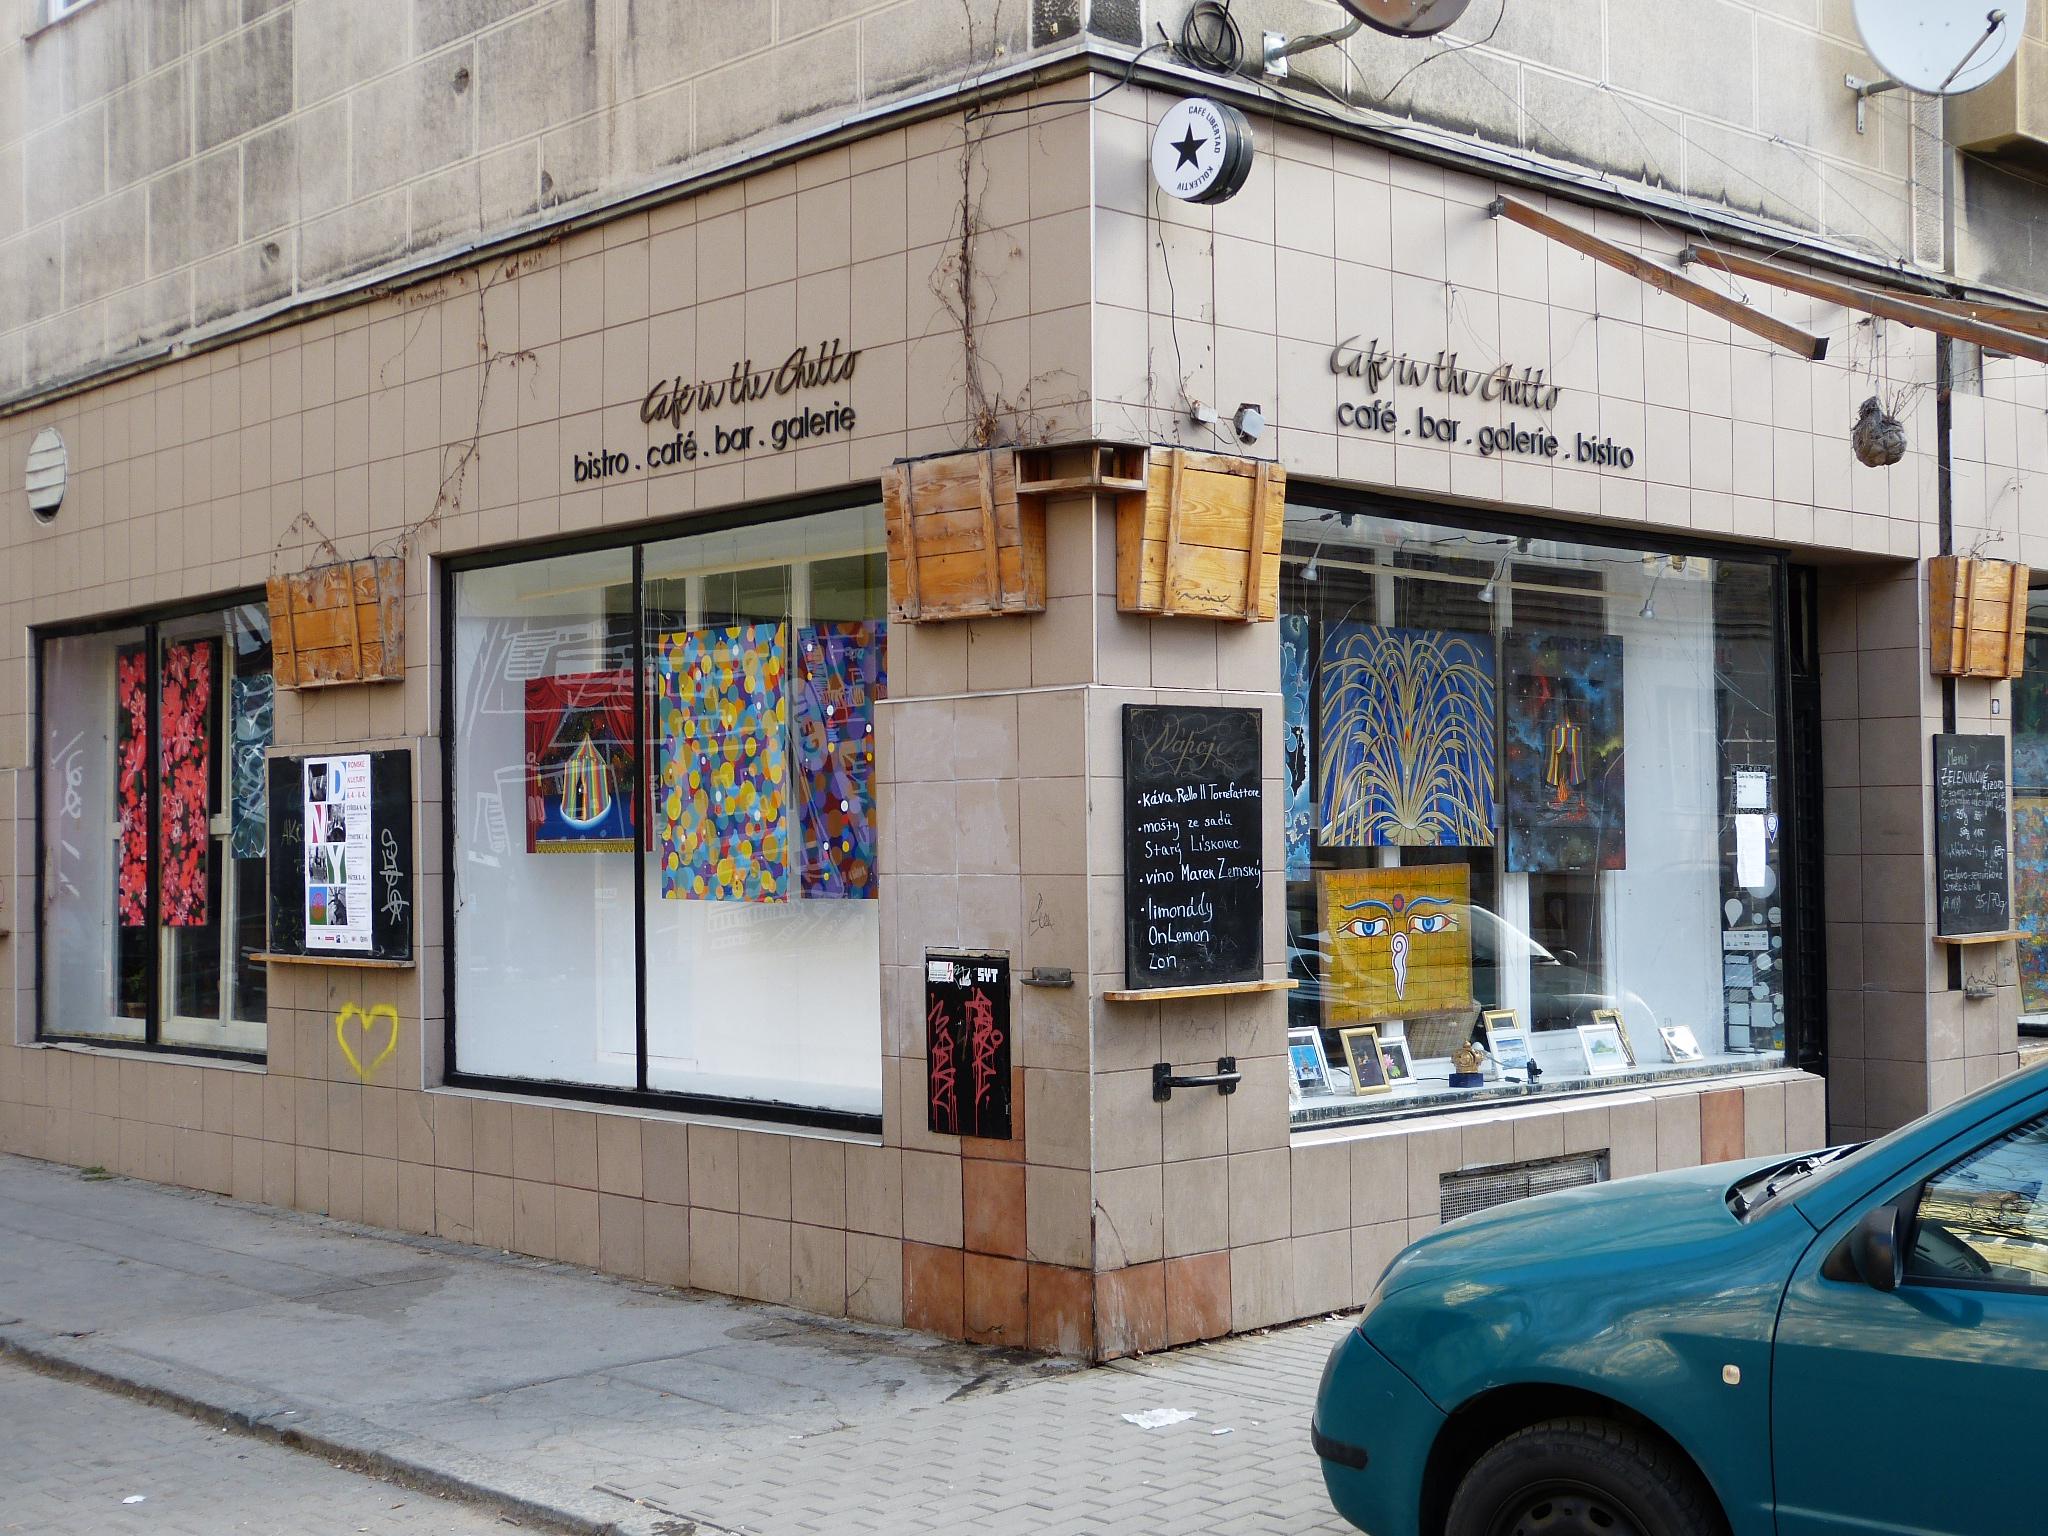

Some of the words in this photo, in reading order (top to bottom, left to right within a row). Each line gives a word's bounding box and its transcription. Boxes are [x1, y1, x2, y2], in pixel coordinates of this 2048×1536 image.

[1189, 106, 1207, 117] CAFÉ
[1206, 113, 1221, 154] LIBERTAD
[1176, 165, 1214, 191] KOLLEKTIV
[640, 375, 697, 429] Café
[698, 380, 726, 411] in
[729, 359, 775, 404] the
[774, 338, 863, 395] Ghetto
[1329, 334, 1395, 394] Café
[1397, 353, 1430, 387] in
[1432, 350, 1482, 396] the
[1480, 361, 1563, 411] Ghetto
[574, 449, 629, 482] bistro
[647, 431, 697, 467] café
[715, 424, 754, 454] bar
[771, 401, 856, 450] galerie
[1337, 399, 1397, 433] café
[1418, 406, 1461, 443] bar
[1479, 422, 1559, 456] galerie
[1577, 432, 1635, 469] bistro
[1143, 817, 1180, 841] mošty
[1188, 818, 1199, 828] ze
[1144, 840, 1182, 864] Starý
[1181, 863, 1215, 882] Marek
[1217, 857, 1261, 889] Zemský
[1148, 891, 1213, 923] limonády
[1148, 922, 1210, 946] OnLemon
[978, 968, 998, 983] SYT
